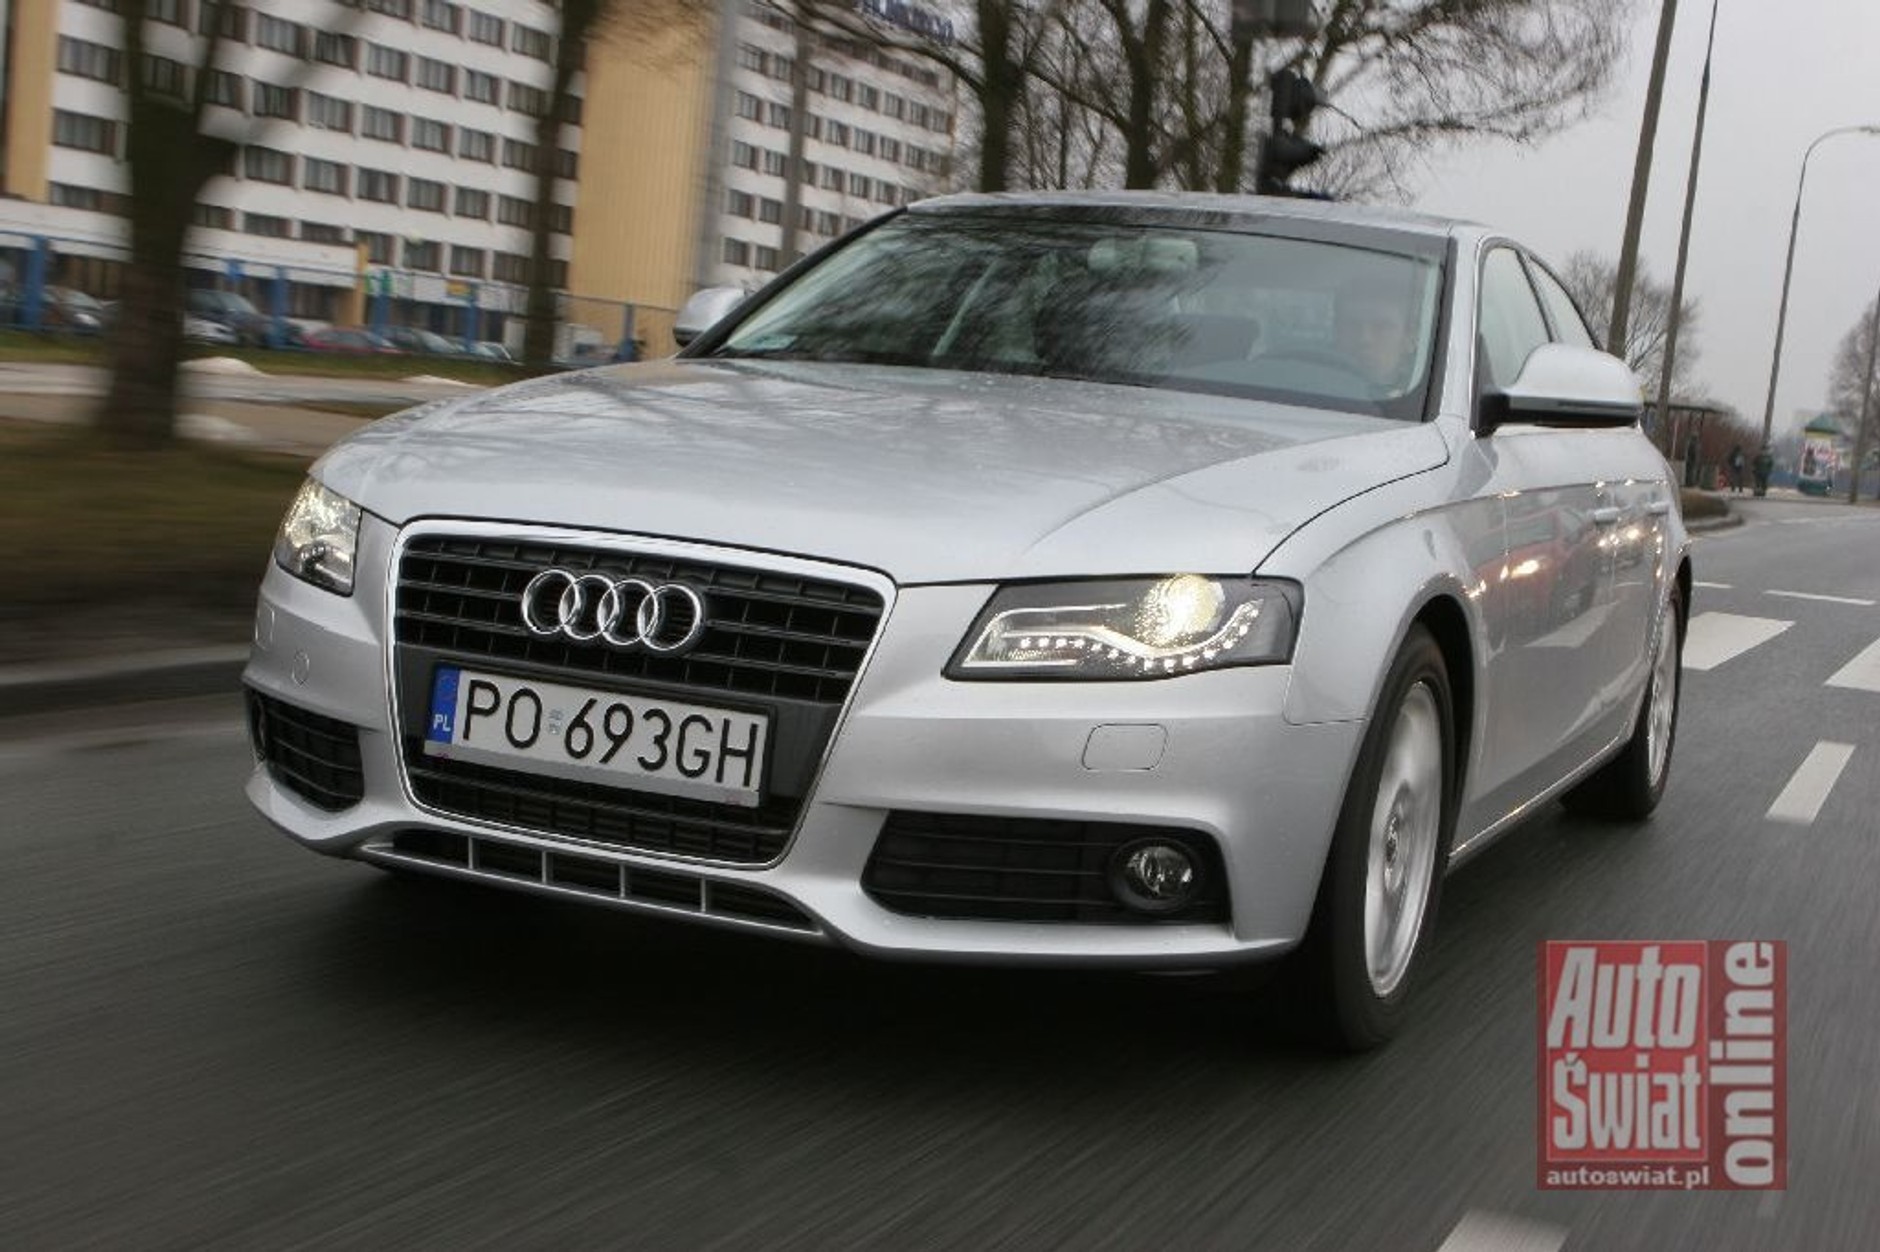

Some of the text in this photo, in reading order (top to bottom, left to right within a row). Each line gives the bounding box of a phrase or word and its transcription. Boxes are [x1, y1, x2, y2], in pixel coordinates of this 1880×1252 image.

[433, 713, 451, 732] PL
[463, 679, 759, 788] PO 693GH
